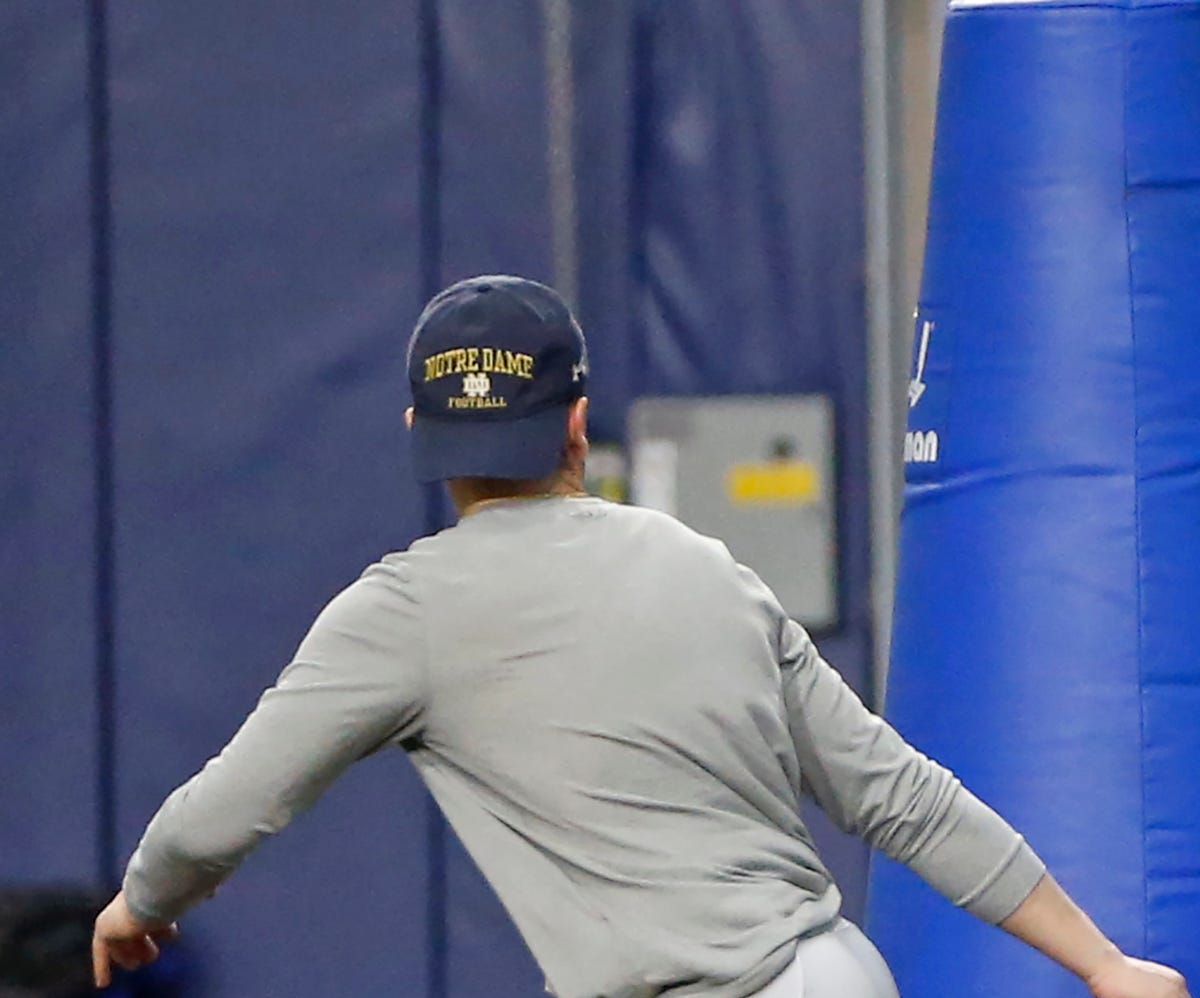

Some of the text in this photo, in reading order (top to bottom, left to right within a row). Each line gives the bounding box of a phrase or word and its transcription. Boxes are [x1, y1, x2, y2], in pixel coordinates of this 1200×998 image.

[424, 348, 534, 381] NOTRE DAME
[448, 397, 508, 408] FOOTBALL
